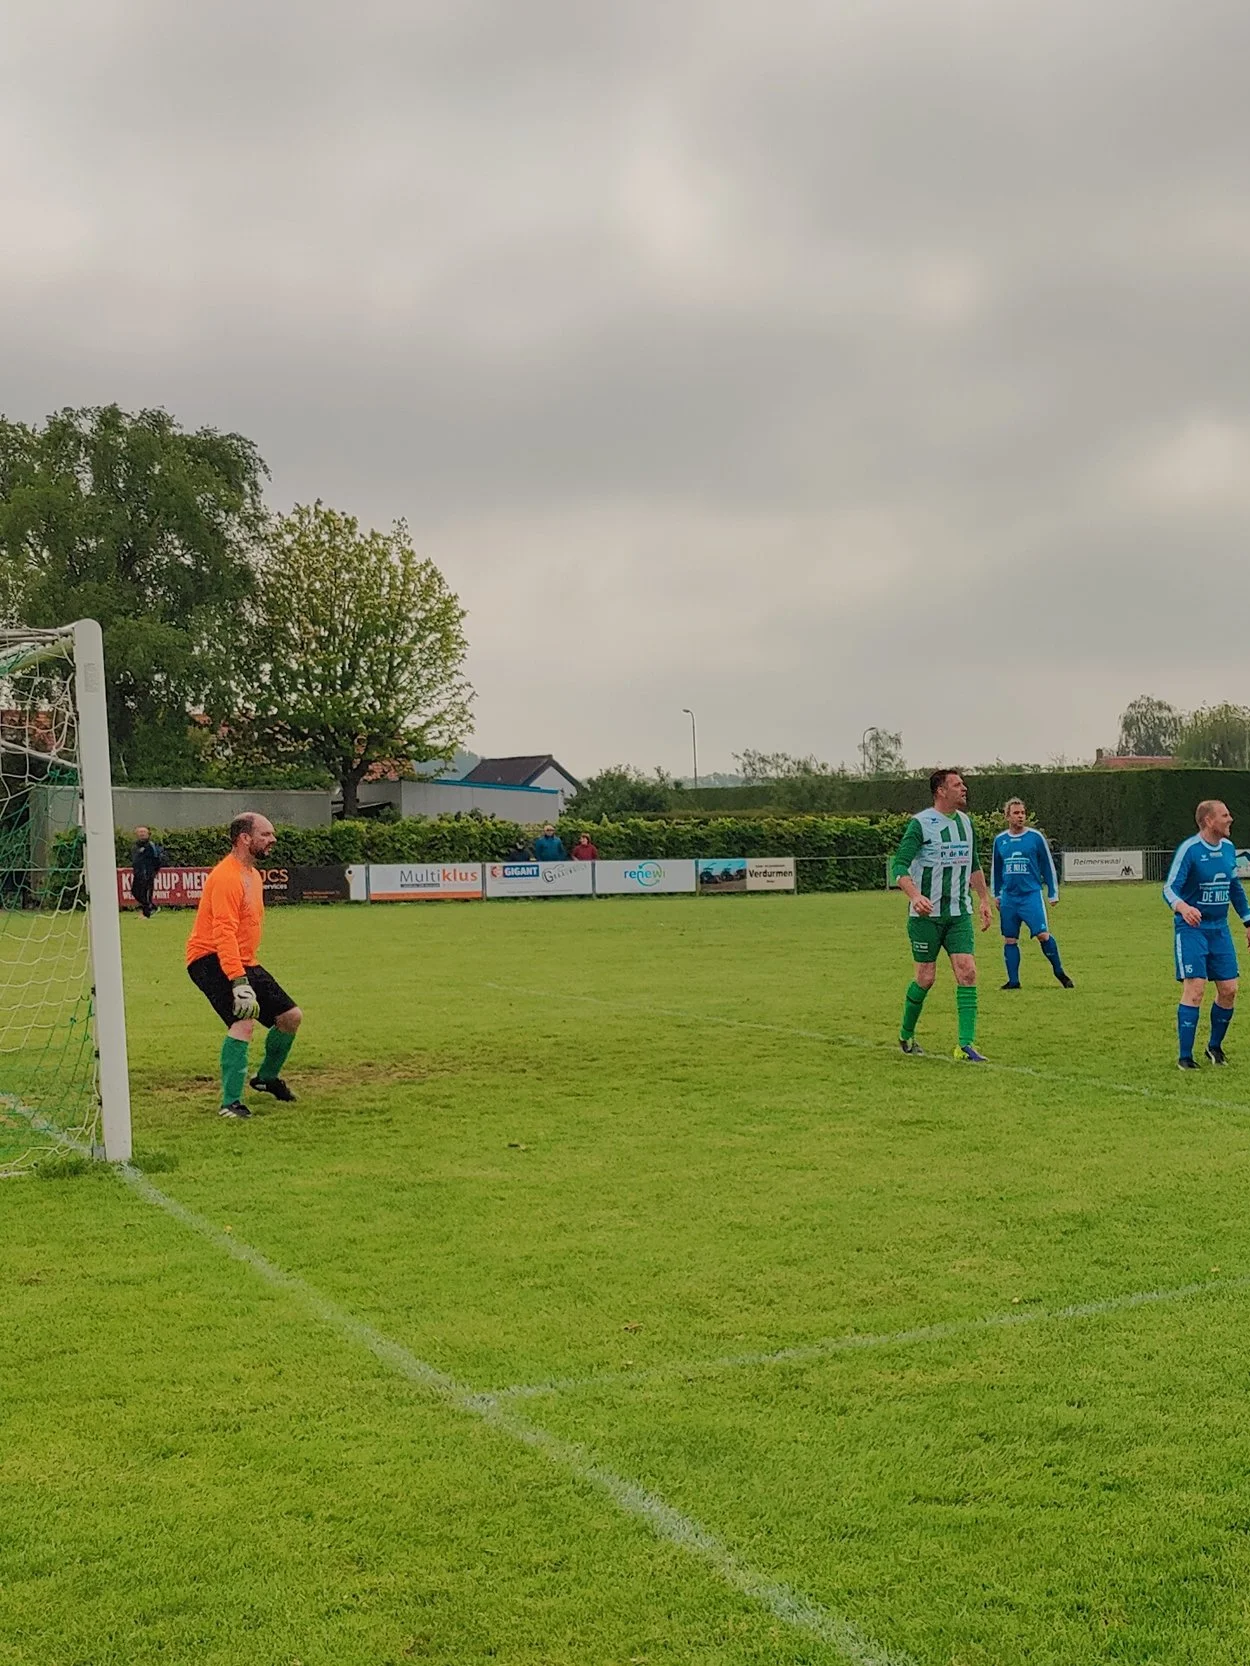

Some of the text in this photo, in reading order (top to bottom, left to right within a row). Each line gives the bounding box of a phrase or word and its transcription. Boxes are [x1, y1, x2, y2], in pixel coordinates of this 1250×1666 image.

[1073, 857, 1121, 865] Reimerswaal
[400, 867, 479, 882] Multiklus
[504, 866, 538, 876] GIGANT
[624, 869, 666, 879] renewi
[748, 868, 793, 878] Verdurmen
